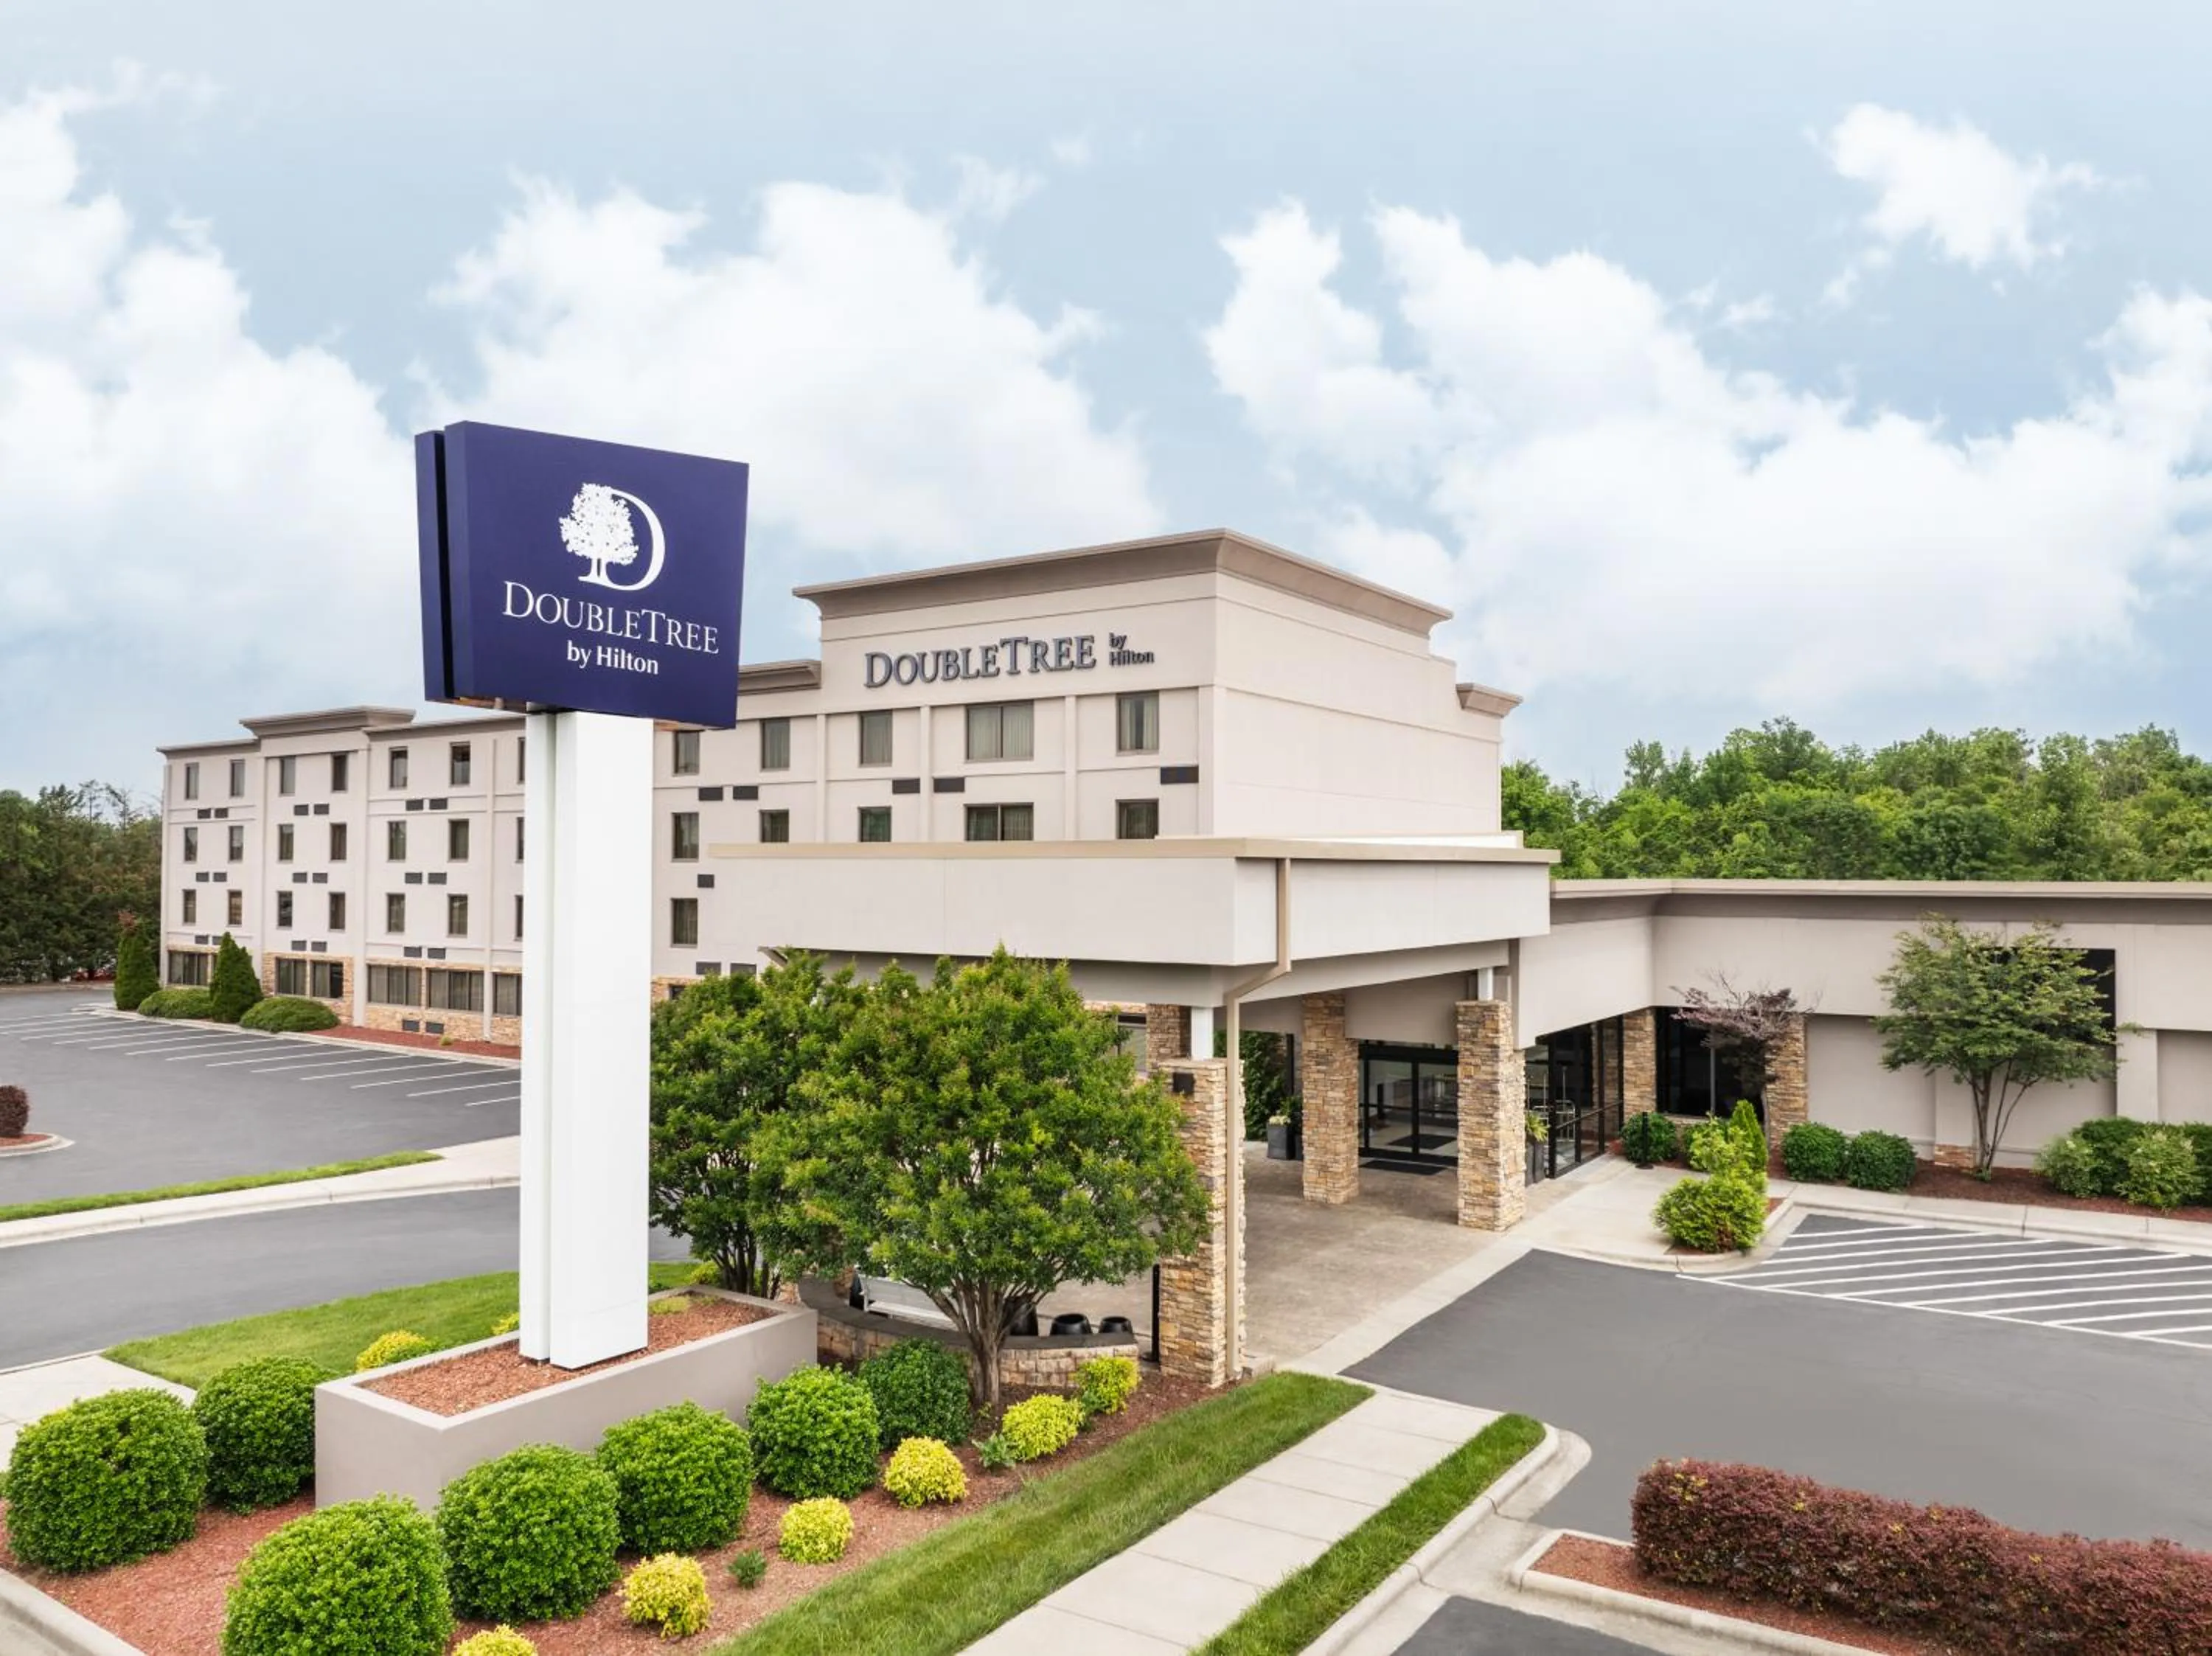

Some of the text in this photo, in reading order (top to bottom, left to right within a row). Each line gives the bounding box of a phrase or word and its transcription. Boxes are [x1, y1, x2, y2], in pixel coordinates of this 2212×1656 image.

[502, 580, 720, 655] DOUBLETREE
[566, 640, 660, 675] by Hilton
[1108, 632, 1127, 649] by
[1108, 649, 1155, 667] Hilton
[863, 635, 1097, 689] DOUBLETREE
